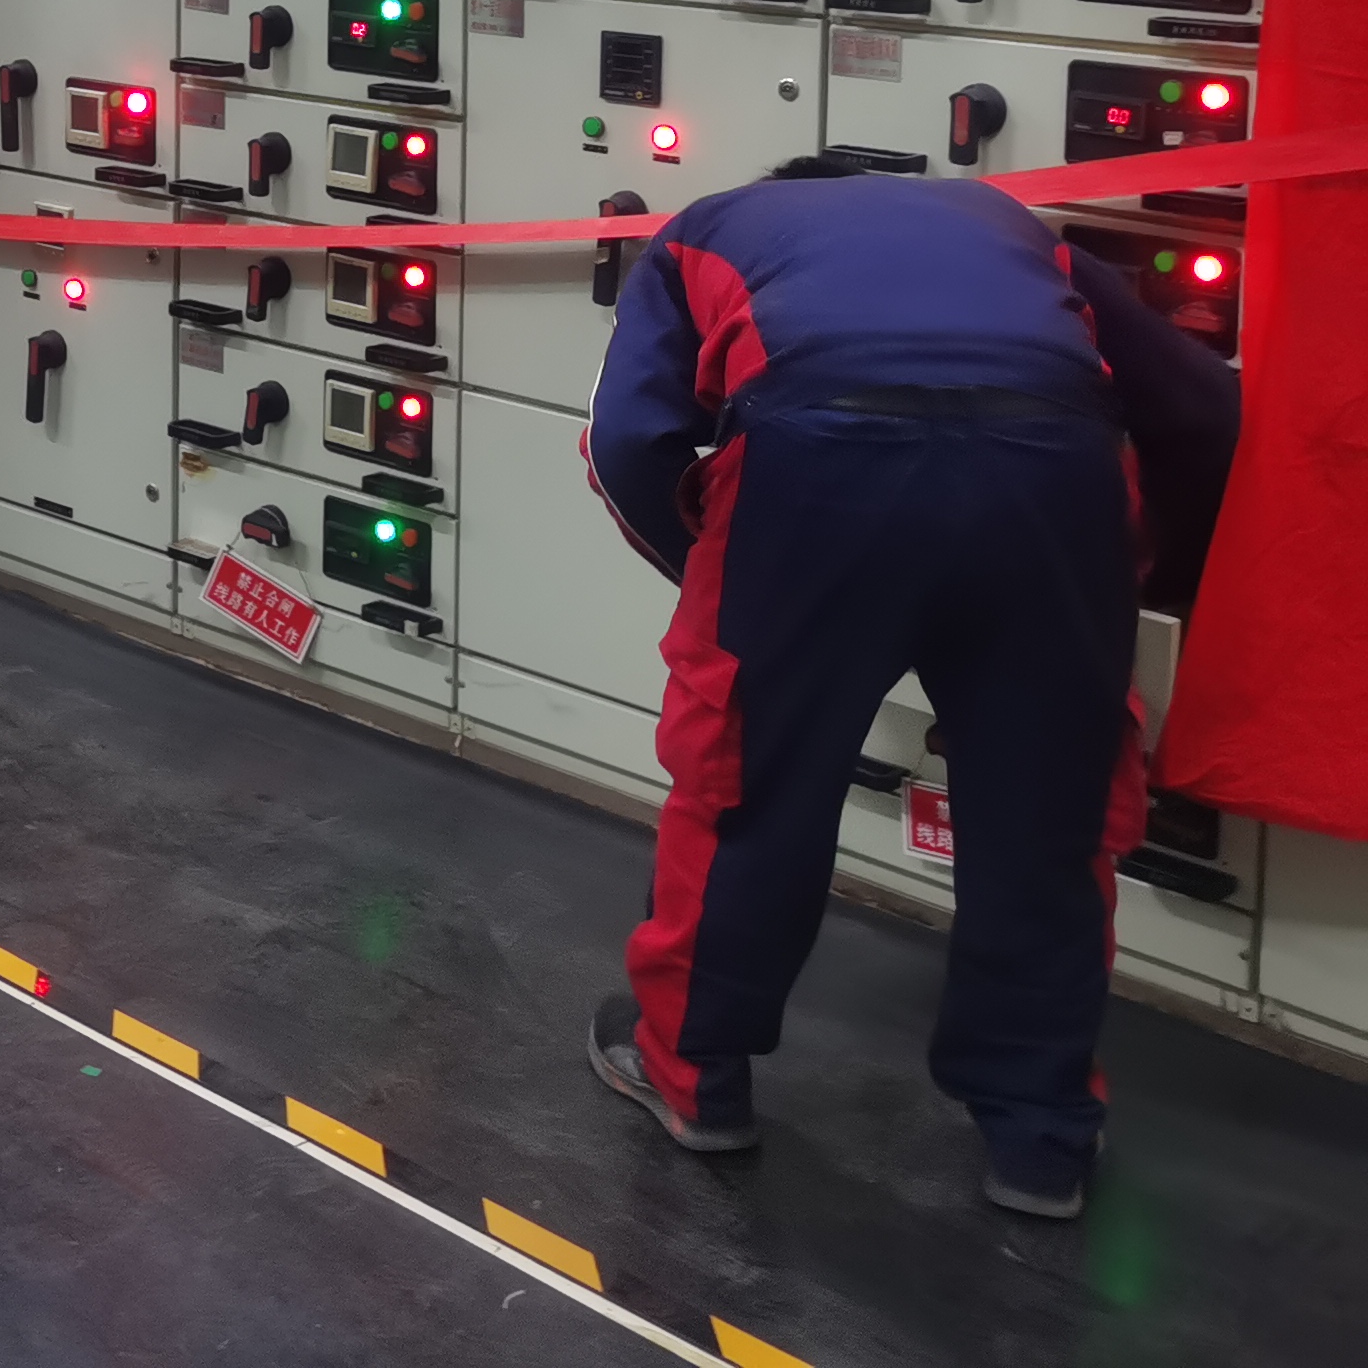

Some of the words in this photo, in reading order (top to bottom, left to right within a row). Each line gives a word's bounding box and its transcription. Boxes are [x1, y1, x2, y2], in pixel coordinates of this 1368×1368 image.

[213, 582, 300, 646] 线路有人工作
[236, 572, 295, 618] 禁止合闸
